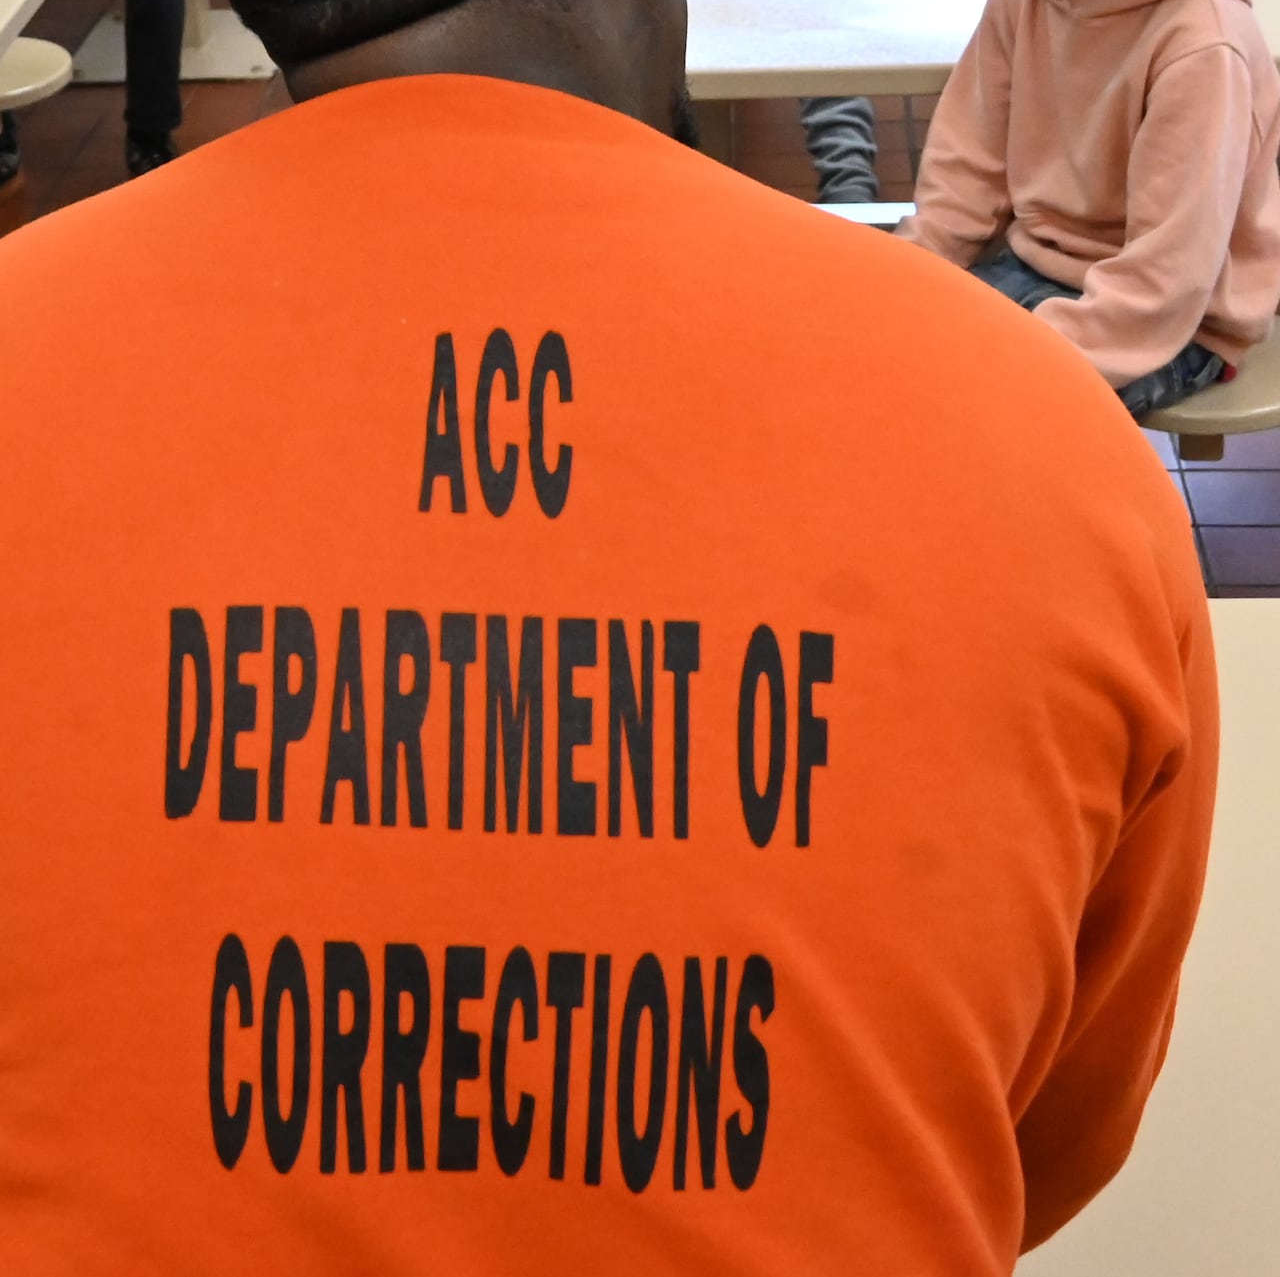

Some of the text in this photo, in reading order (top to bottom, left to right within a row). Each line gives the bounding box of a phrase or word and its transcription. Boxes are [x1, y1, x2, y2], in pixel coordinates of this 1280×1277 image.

[418, 326, 574, 519] ACC
[163, 604, 835, 849] DEPARTMENT OF
[207, 932, 776, 1195] CORRECTIONS
